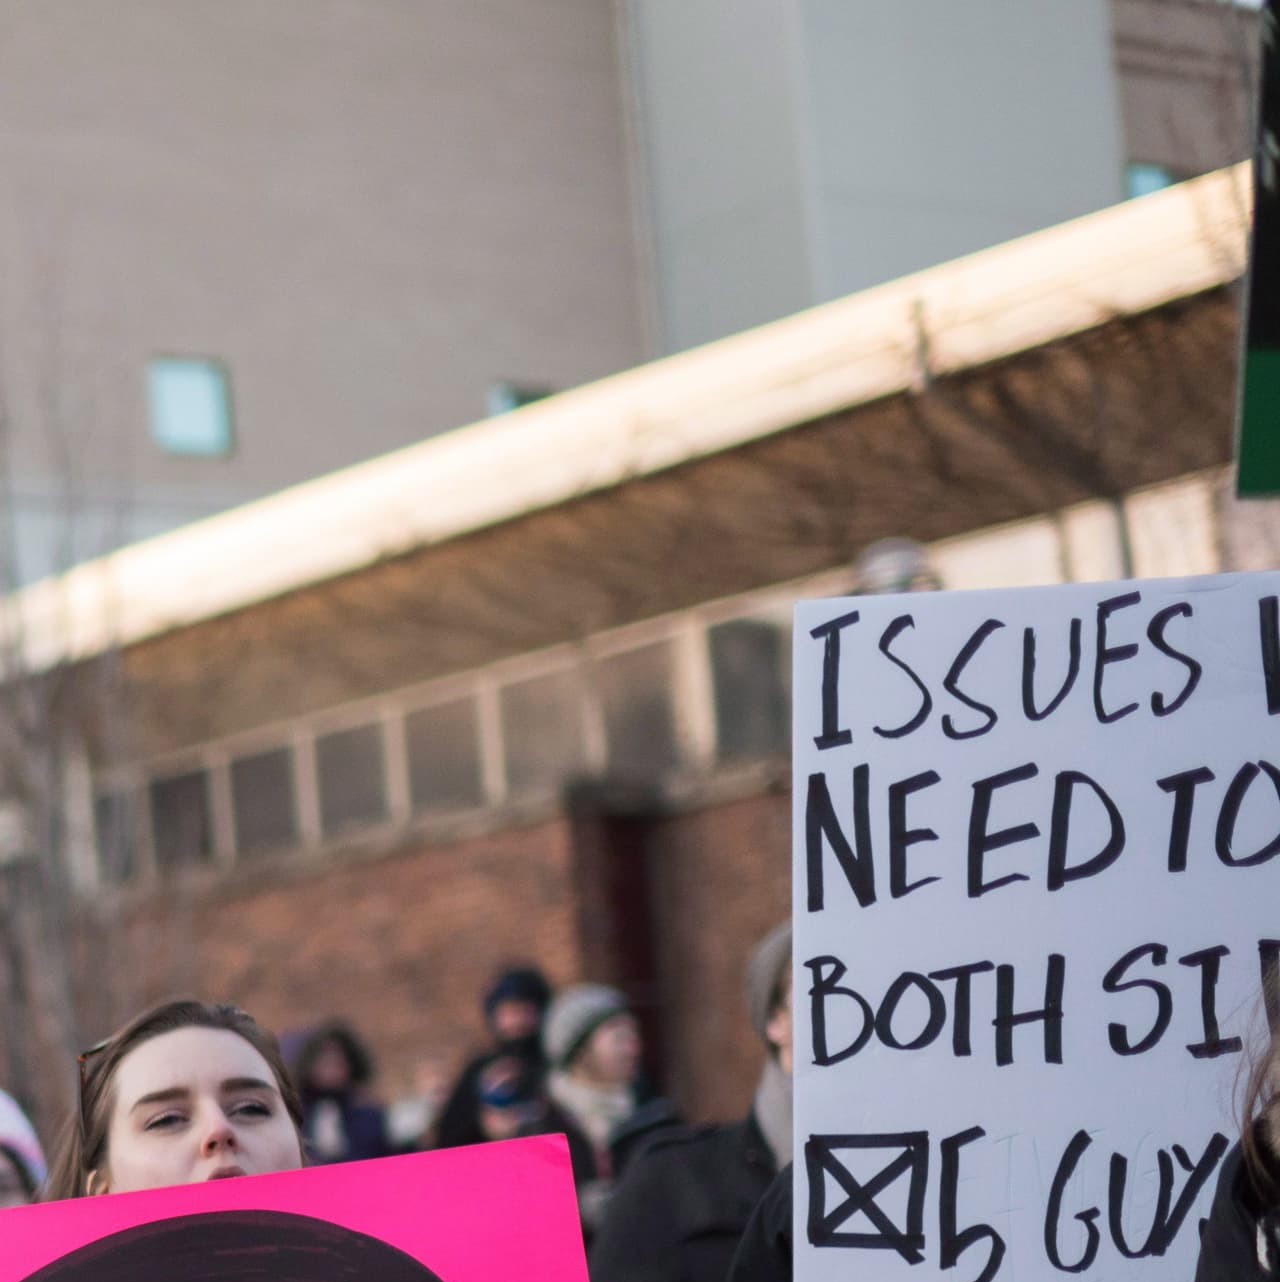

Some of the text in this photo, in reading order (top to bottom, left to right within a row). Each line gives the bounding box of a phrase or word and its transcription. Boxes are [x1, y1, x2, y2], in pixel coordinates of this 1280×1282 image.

[810, 591, 1202, 750] ISSUES
[805, 760, 1280, 912] NEED TO
[804, 953, 1065, 1066] BOTH
[1044, 1129, 1228, 1273] GUY
